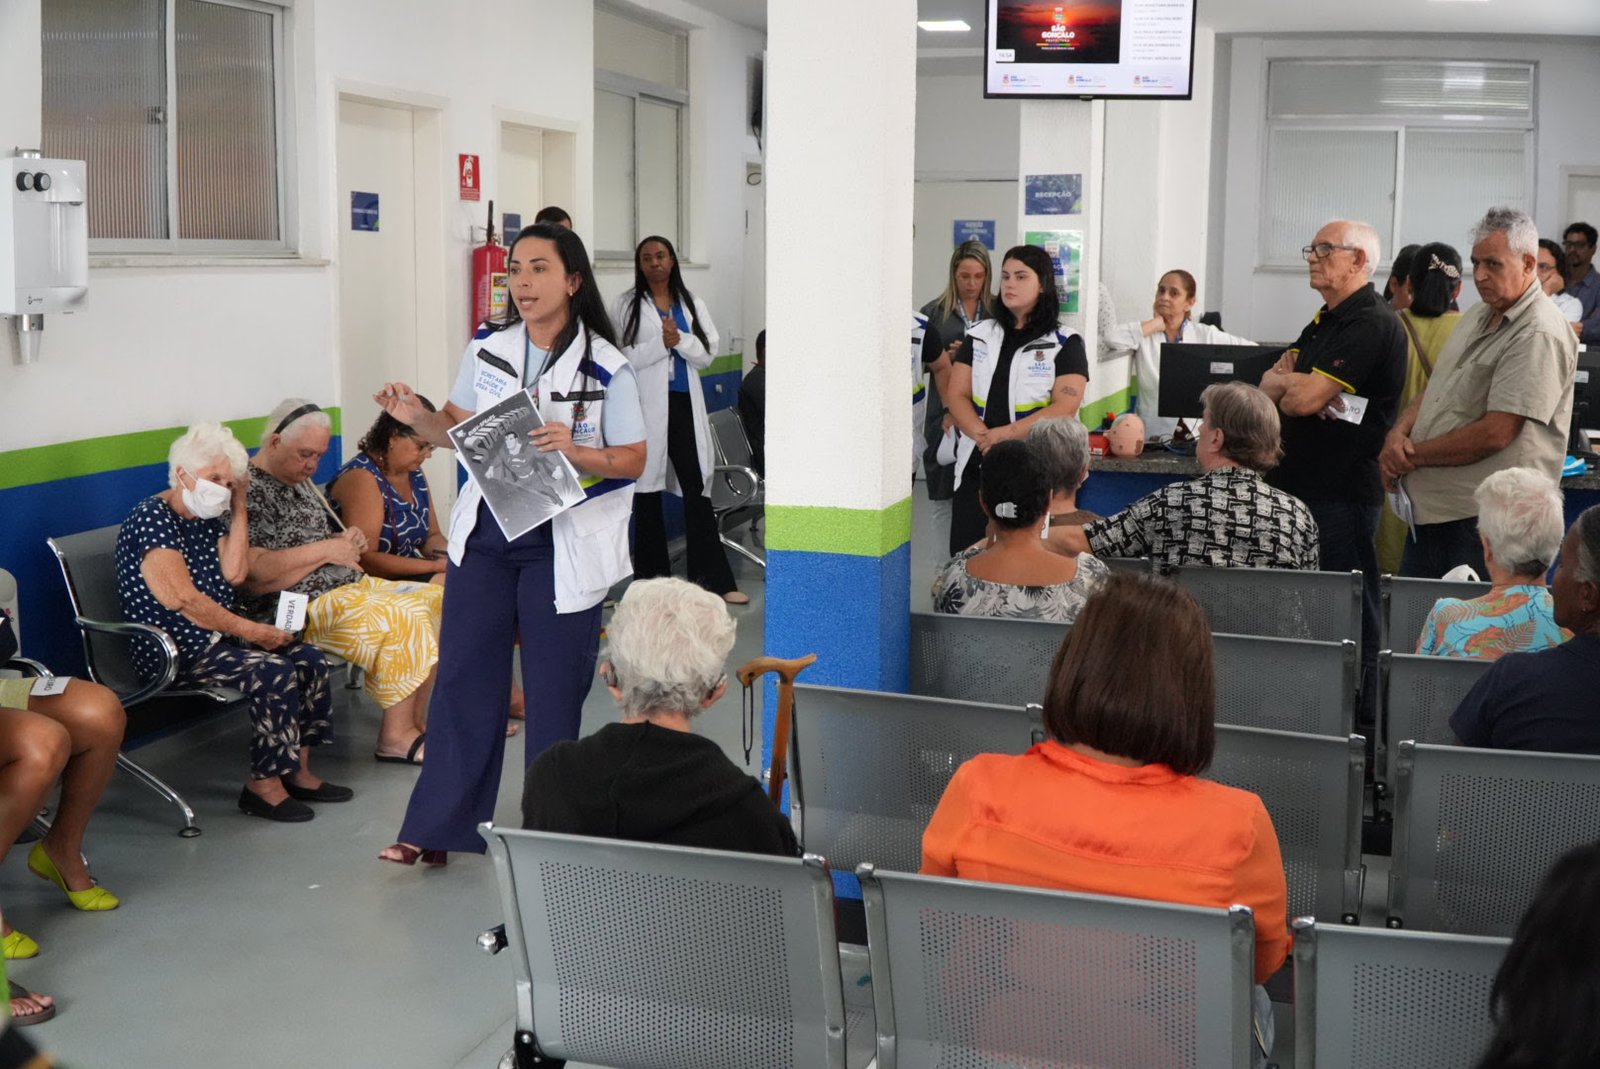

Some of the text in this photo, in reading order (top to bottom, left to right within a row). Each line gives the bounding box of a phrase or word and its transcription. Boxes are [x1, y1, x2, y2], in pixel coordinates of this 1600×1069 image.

[1051, 23, 1066, 32] SÃO
[1034, 190, 1072, 199] RECEPÇÃO
[464, 407, 530, 464] SUPERMAN
